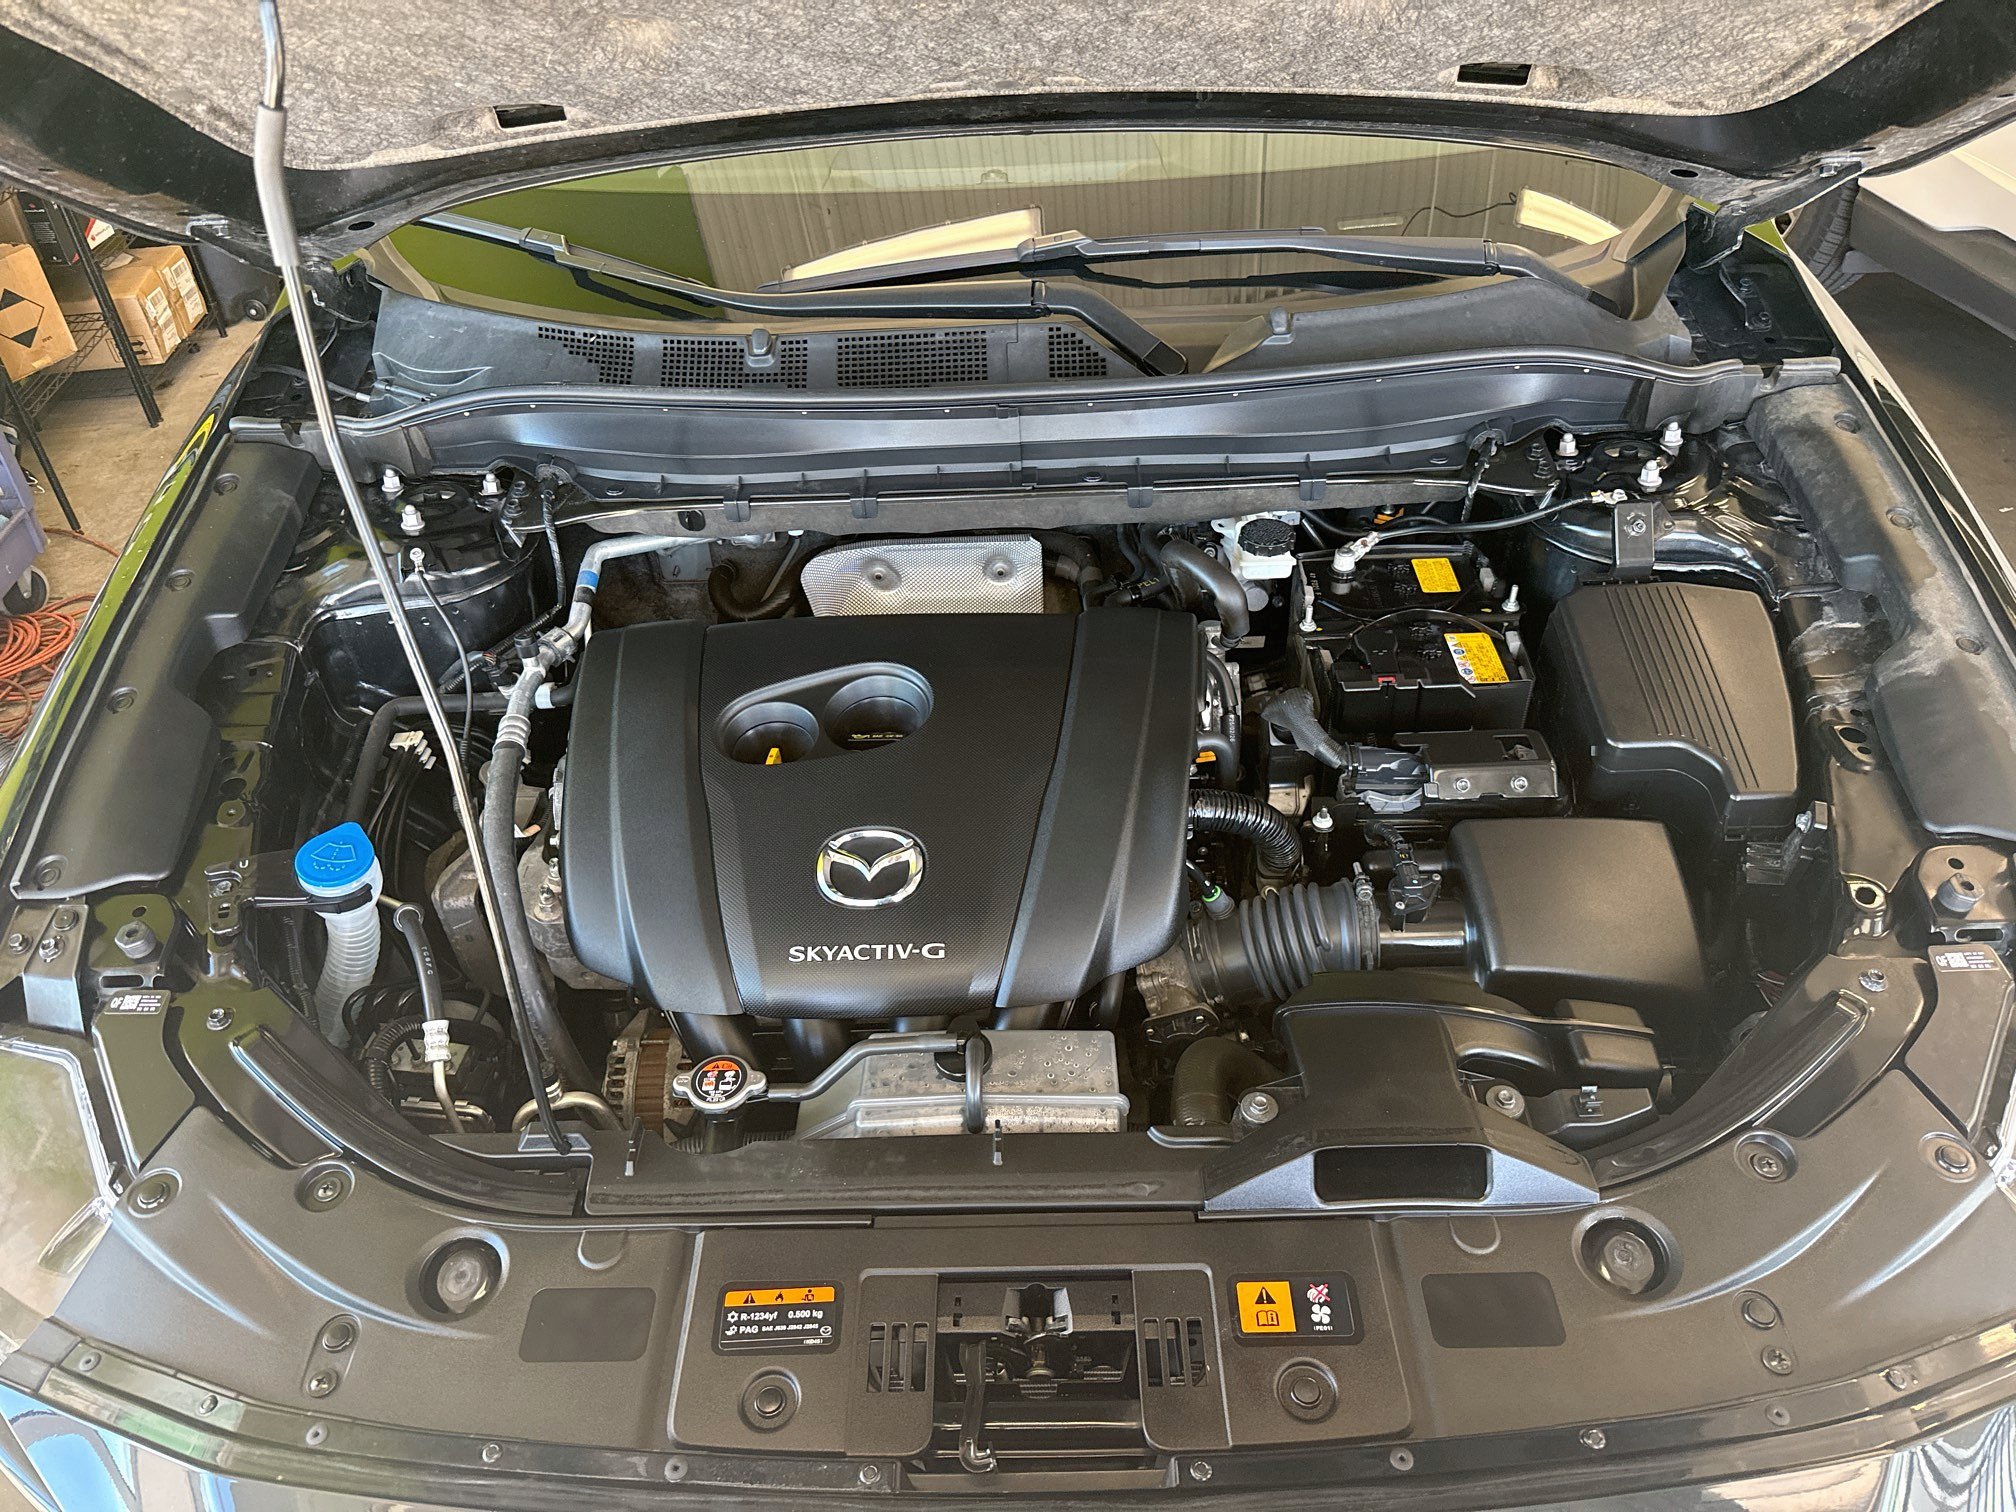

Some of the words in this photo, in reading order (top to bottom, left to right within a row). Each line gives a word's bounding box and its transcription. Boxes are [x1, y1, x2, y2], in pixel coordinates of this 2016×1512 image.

[788, 942, 946, 963] SKYACTIV-G
[740, 1311, 778, 1321] R-1234yf
[787, 1310, 811, 1319] 0.500
[812, 1309, 823, 1319] kg
[739, 1325, 759, 1334] PAG
